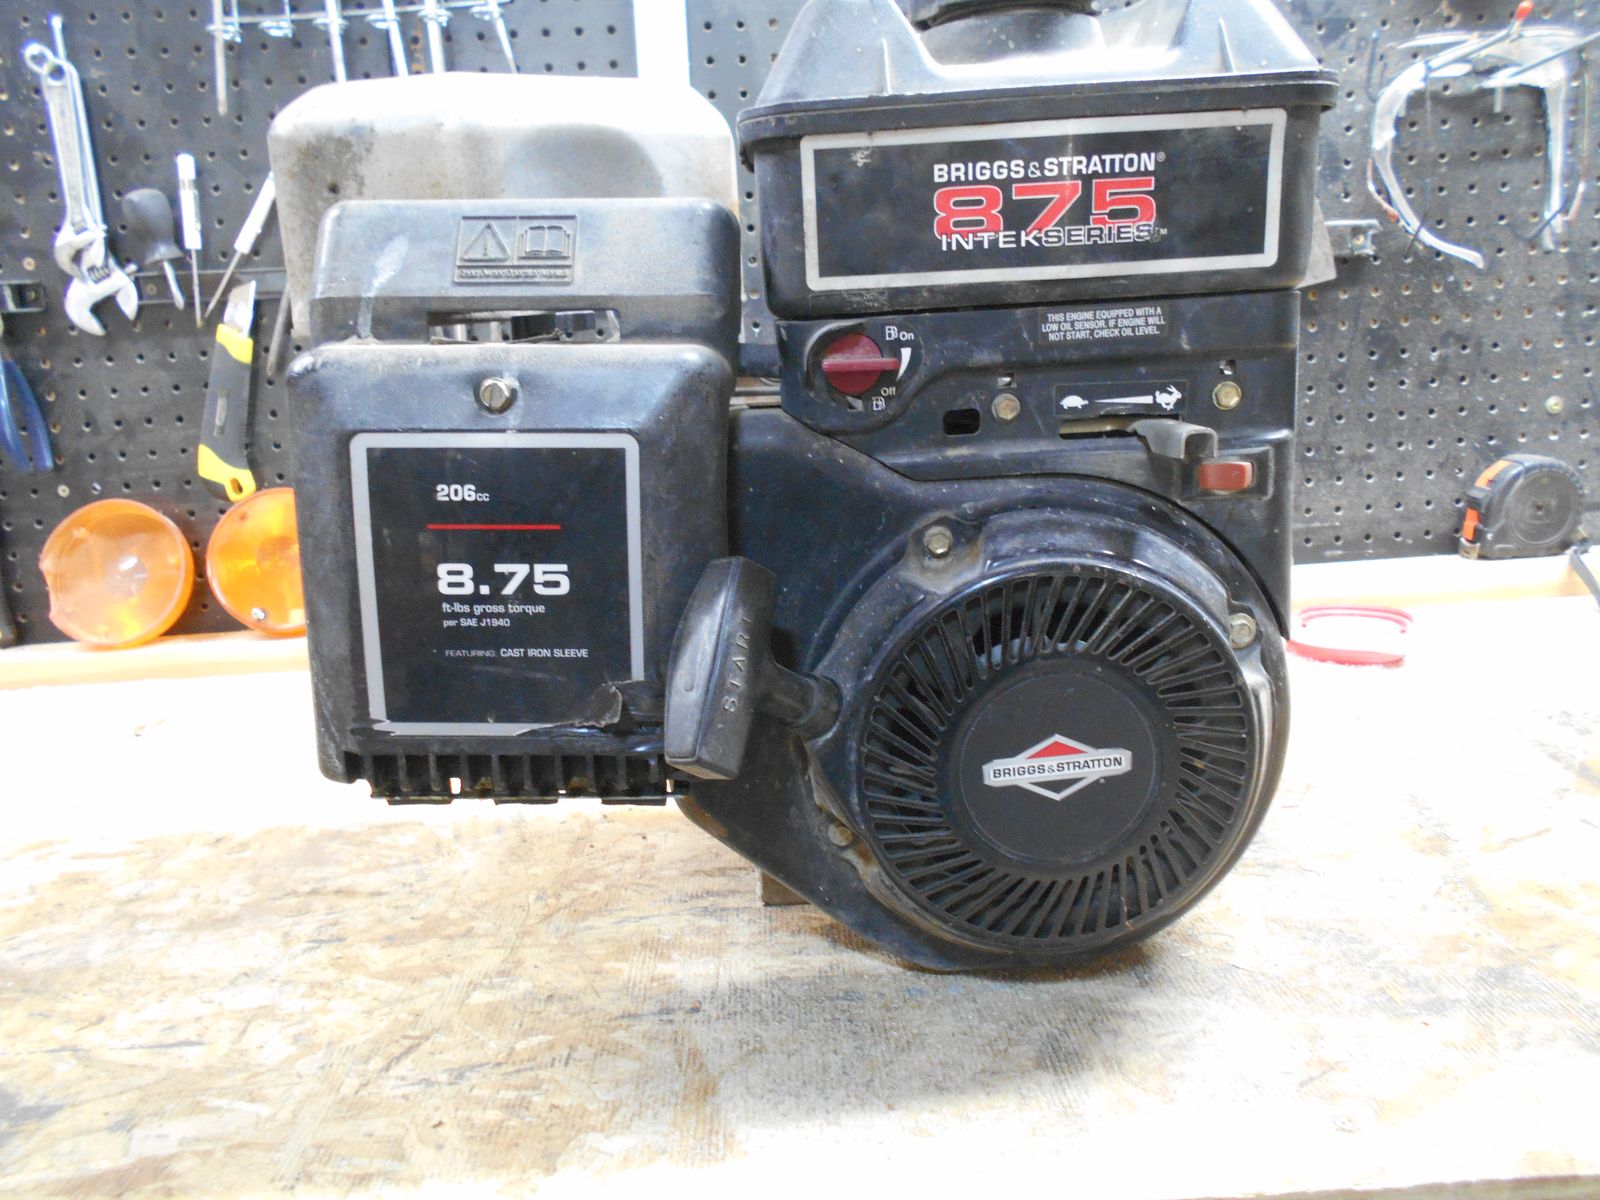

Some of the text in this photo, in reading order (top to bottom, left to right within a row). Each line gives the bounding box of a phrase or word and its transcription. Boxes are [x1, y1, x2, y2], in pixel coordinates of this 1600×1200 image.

[933, 176, 1157, 241] 875
[1047, 306, 1162, 322] THIS ENGINE EQUIPPED WITH A
[1042, 323, 1059, 332] LOW
[1060, 322, 1073, 331] OIL
[1108, 319, 1117, 328] IF
[1117, 317, 1146, 327] ENGINE
[1147, 316, 1166, 325] WILL
[899, 331, 915, 341] On
[1048, 332, 1064, 341] NOT
[1065, 330, 1093, 340] START,
[1094, 328, 1120, 338] CHECK
[1121, 327, 1134, 337] OIL
[880, 386, 897, 396] Off
[436, 563, 571, 596] 8.75
[441, 602, 546, 616] ft-lbs gross torque
[443, 618, 511, 628] per SAE J1940
[445, 649, 589, 658] FEATURING: CAST IRON SLEEVE
[722, 607, 751, 713] START
